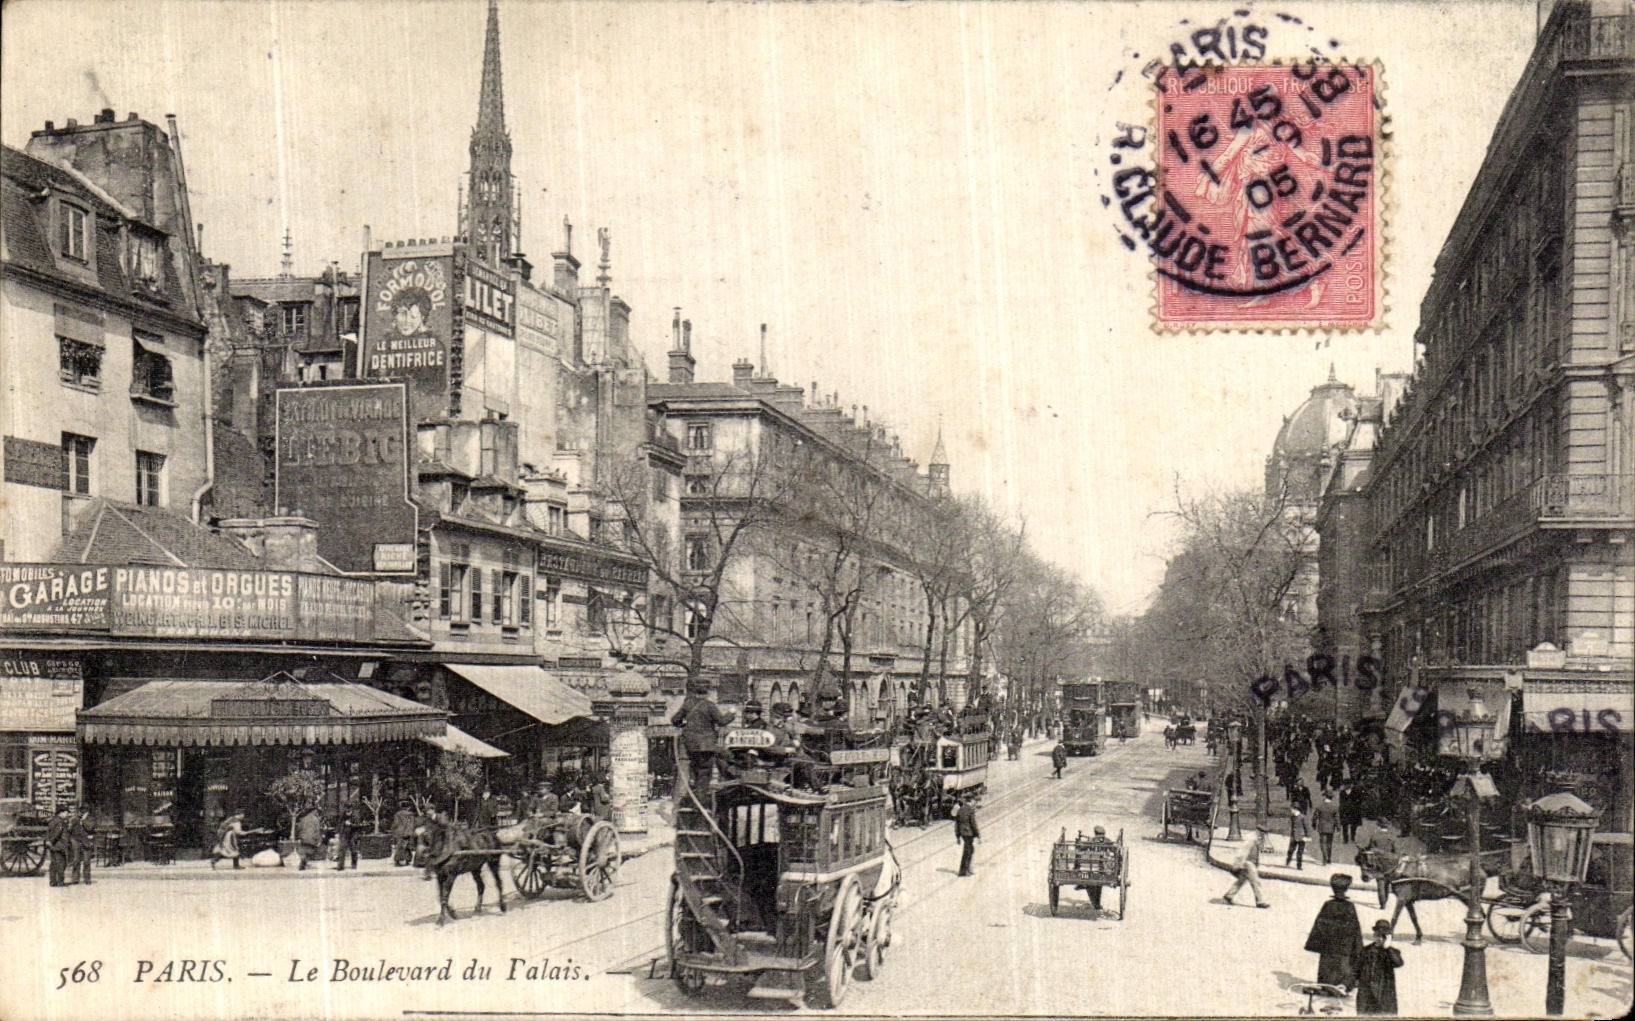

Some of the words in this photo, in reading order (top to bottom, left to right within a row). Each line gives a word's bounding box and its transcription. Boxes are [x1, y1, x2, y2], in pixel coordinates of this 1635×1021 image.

[375, 273, 446, 312] FORMODOL
[464, 275, 513, 324] LILET
[376, 341, 387, 352] LE
[390, 338, 437, 351] MEILLEUR
[371, 350, 444, 371] DENTIFRICE
[9, 567, 108, 609] GARAGE
[116, 568, 190, 594] PIANOS
[193, 579, 208, 595] et
[211, 572, 293, 597] ORGUES
[122, 593, 180, 610] LOCATION
[4, 661, 40, 676] CLUB
